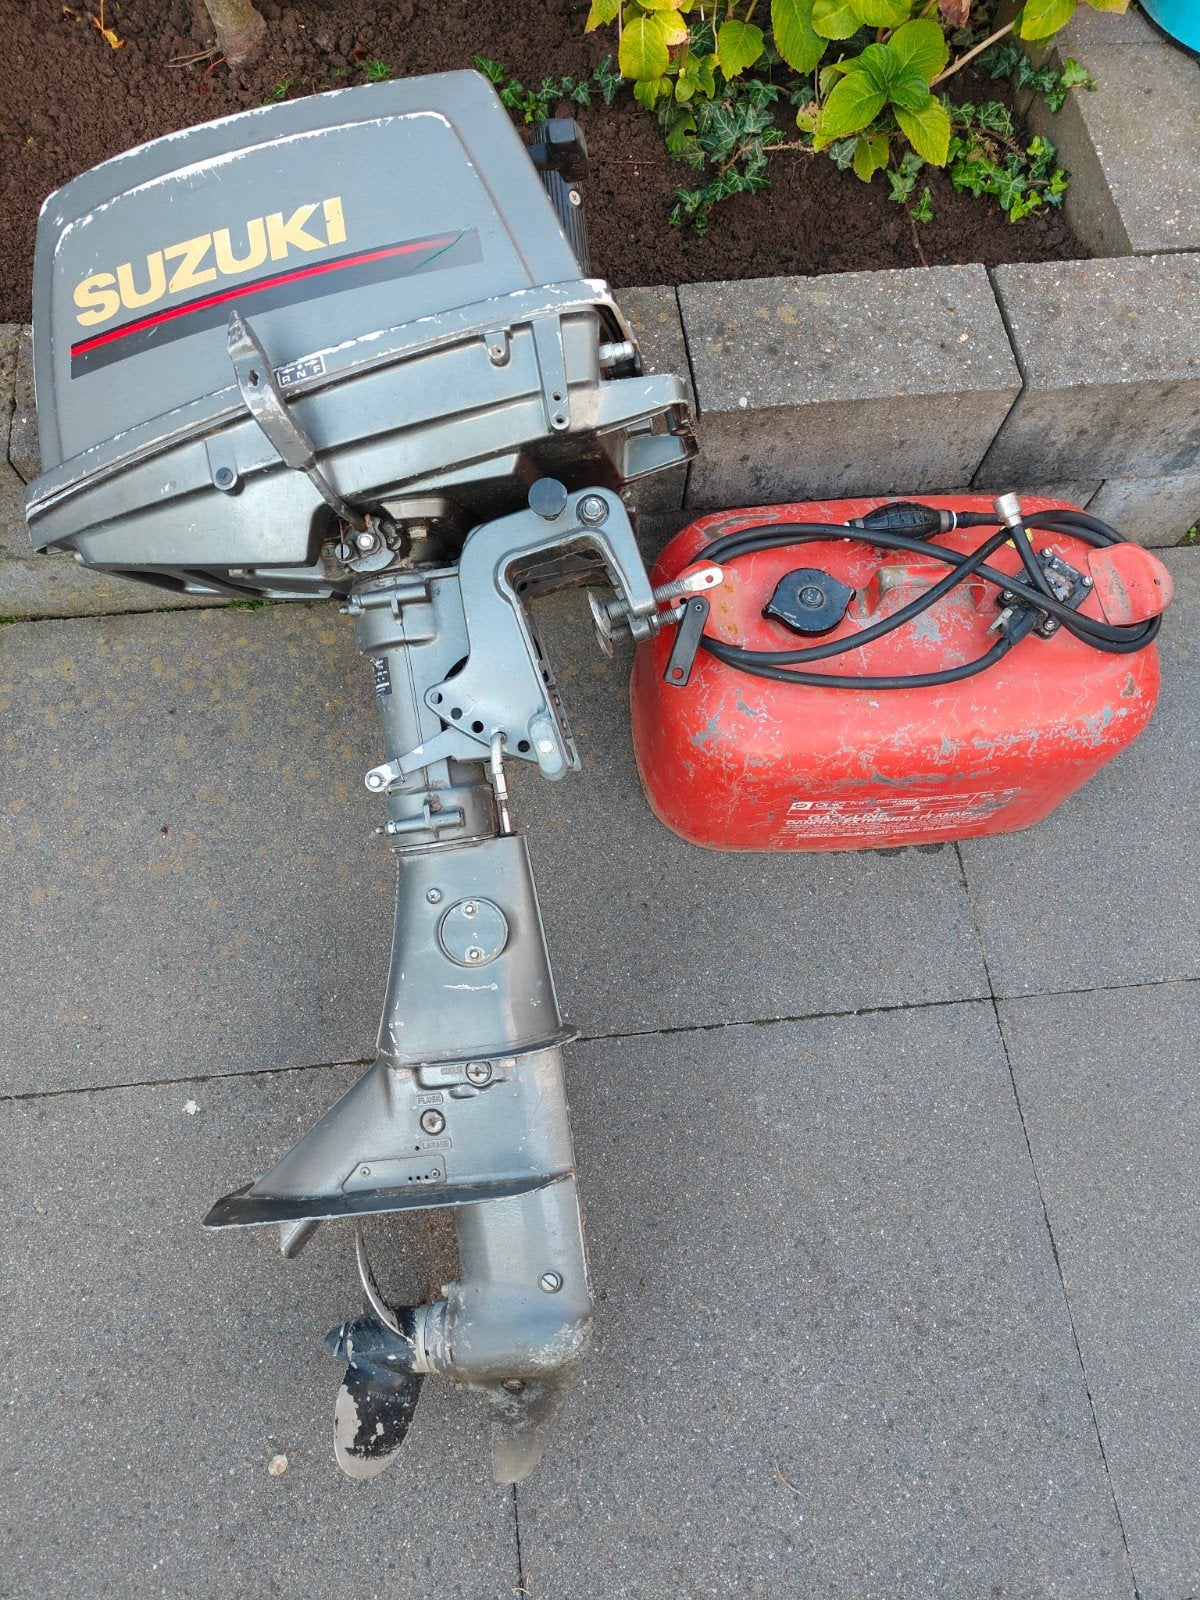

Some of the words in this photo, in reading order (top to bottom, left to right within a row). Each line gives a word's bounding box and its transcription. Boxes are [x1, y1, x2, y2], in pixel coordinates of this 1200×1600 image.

[74, 196, 346, 327] SUZUKI
[282, 375, 291, 384] R
[296, 370, 307, 379] N
[313, 365, 321, 373] F
